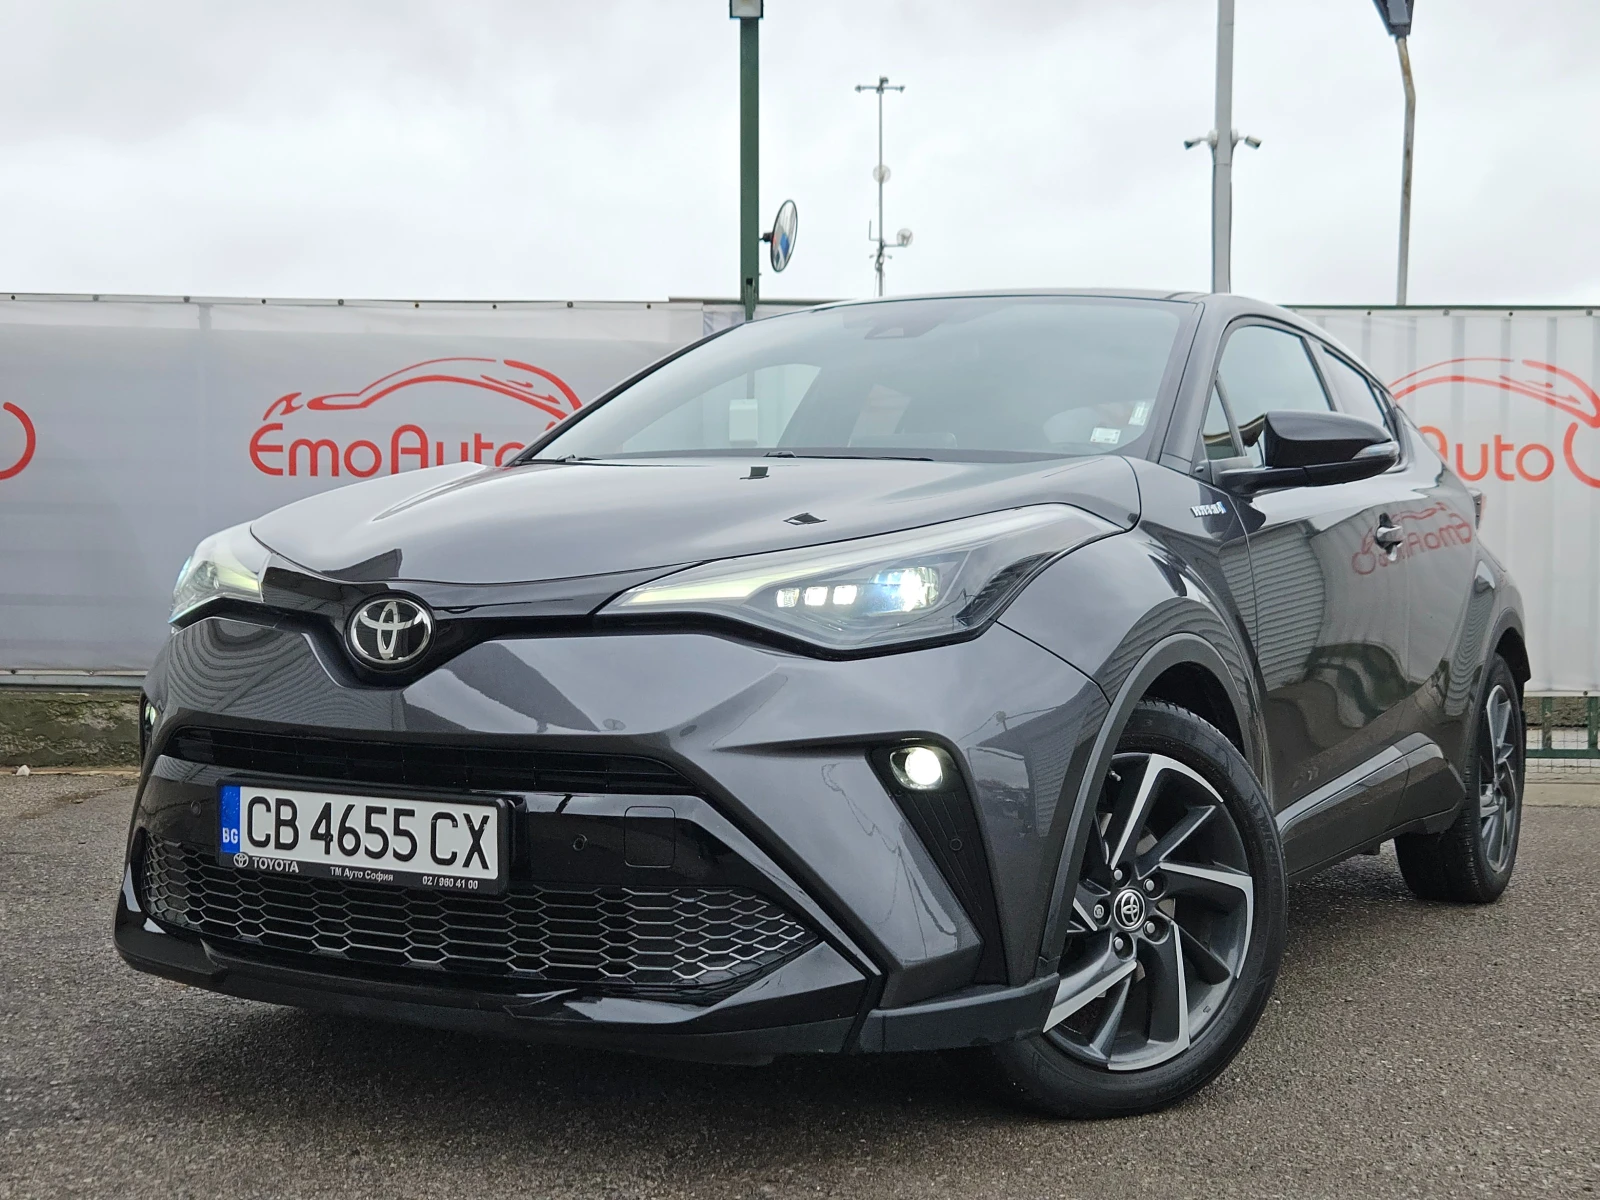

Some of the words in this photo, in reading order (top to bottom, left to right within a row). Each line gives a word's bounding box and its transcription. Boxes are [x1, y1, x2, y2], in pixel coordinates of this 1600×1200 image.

[222, 827, 239, 845] BG
[246, 796, 299, 850] CB
[310, 802, 418, 862] 4655
[430, 812, 490, 870] CX
[252, 857, 299, 874] TOYOTA
[343, 867, 364, 880] Ауто
[365, 870, 394, 883] София
[422, 875, 433, 886] 02
[455, 879, 466, 889] 41
[468, 880, 479, 890] 00
